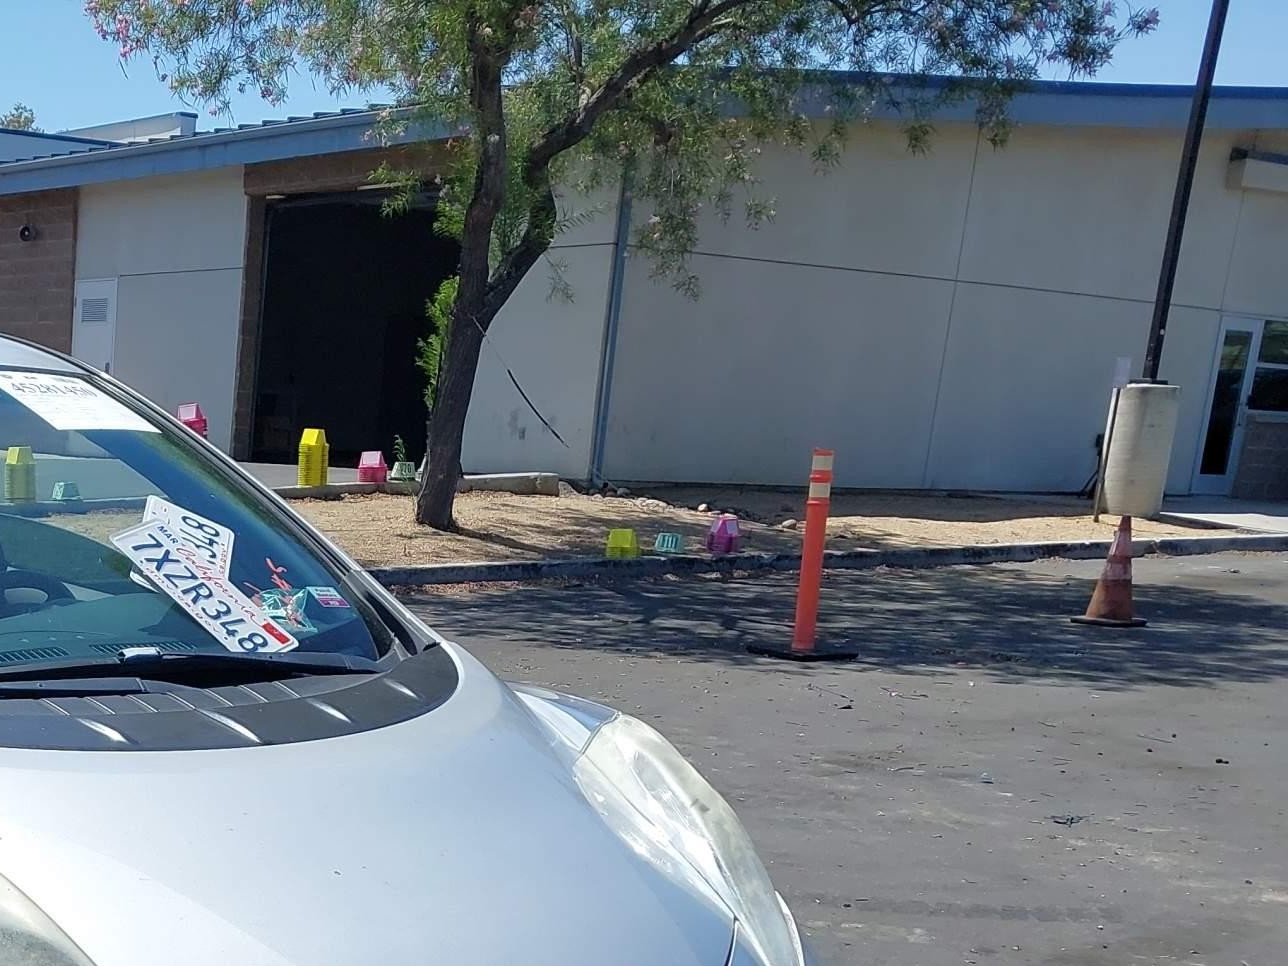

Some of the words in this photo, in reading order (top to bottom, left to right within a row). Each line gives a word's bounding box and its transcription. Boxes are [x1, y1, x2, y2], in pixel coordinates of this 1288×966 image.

[156, 526, 179, 544] MAR
[131, 533, 269, 653] 7XZR348
[175, 547, 263, 628] California
